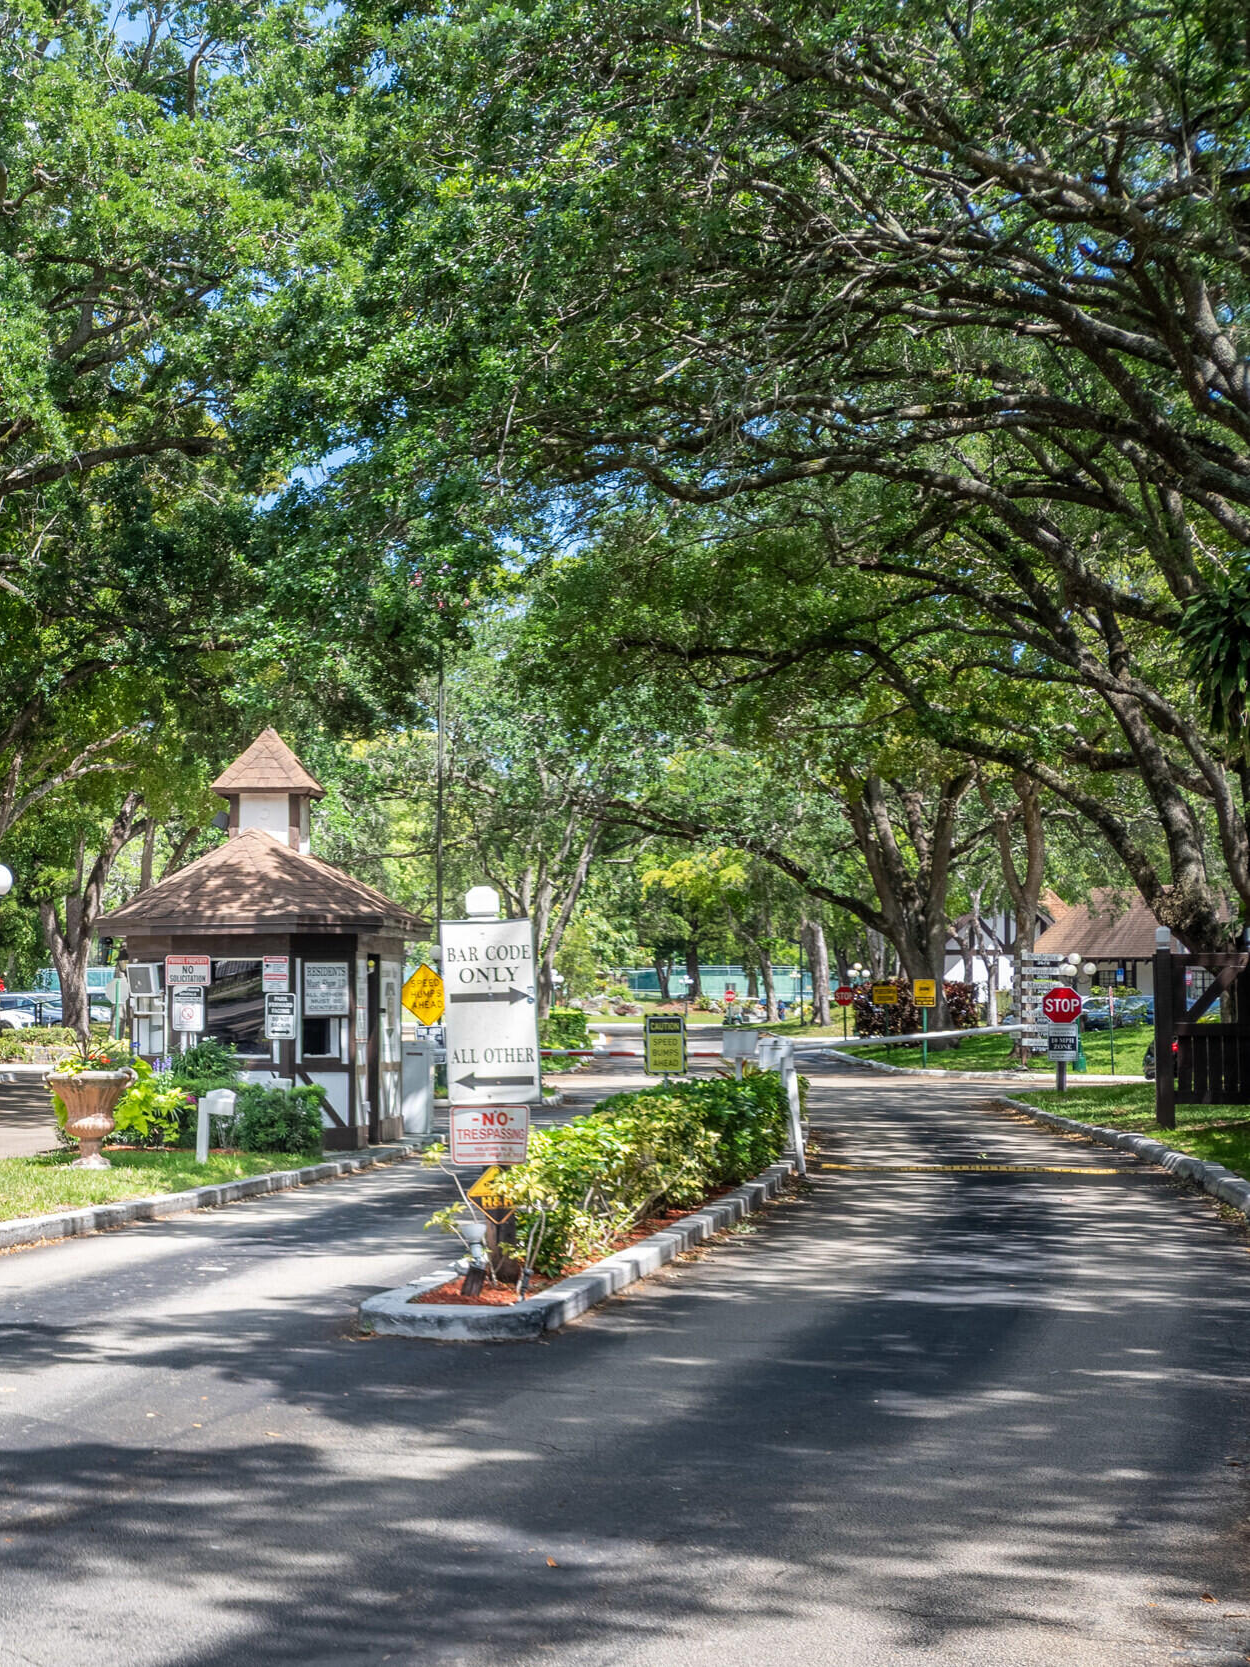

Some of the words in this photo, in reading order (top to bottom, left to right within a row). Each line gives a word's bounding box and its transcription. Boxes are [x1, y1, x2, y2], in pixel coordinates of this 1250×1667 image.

[447, 947, 479, 962] BAR
[485, 945, 531, 961] CODE
[182, 965, 194, 974] NO
[306, 966, 346, 977] RESIDENTS
[169, 975, 207, 983] SOLICITATION
[459, 966, 519, 984] ONLY
[410, 979, 440, 988] SPEED
[410, 989, 442, 999] HUMPS
[411, 1000, 444, 1010] AHEAD
[1045, 998, 1080, 1012] STOP
[650, 1022, 680, 1031] CAUTION
[653, 1038, 678, 1046] SPEED
[451, 1049, 479, 1064] ALL
[484, 1048, 534, 1063] OTHER
[652, 1048, 679, 1057] BUMPS
[653, 1059, 679, 1067] AHEAD
[456, 1128, 525, 1140] TRESPASSING
